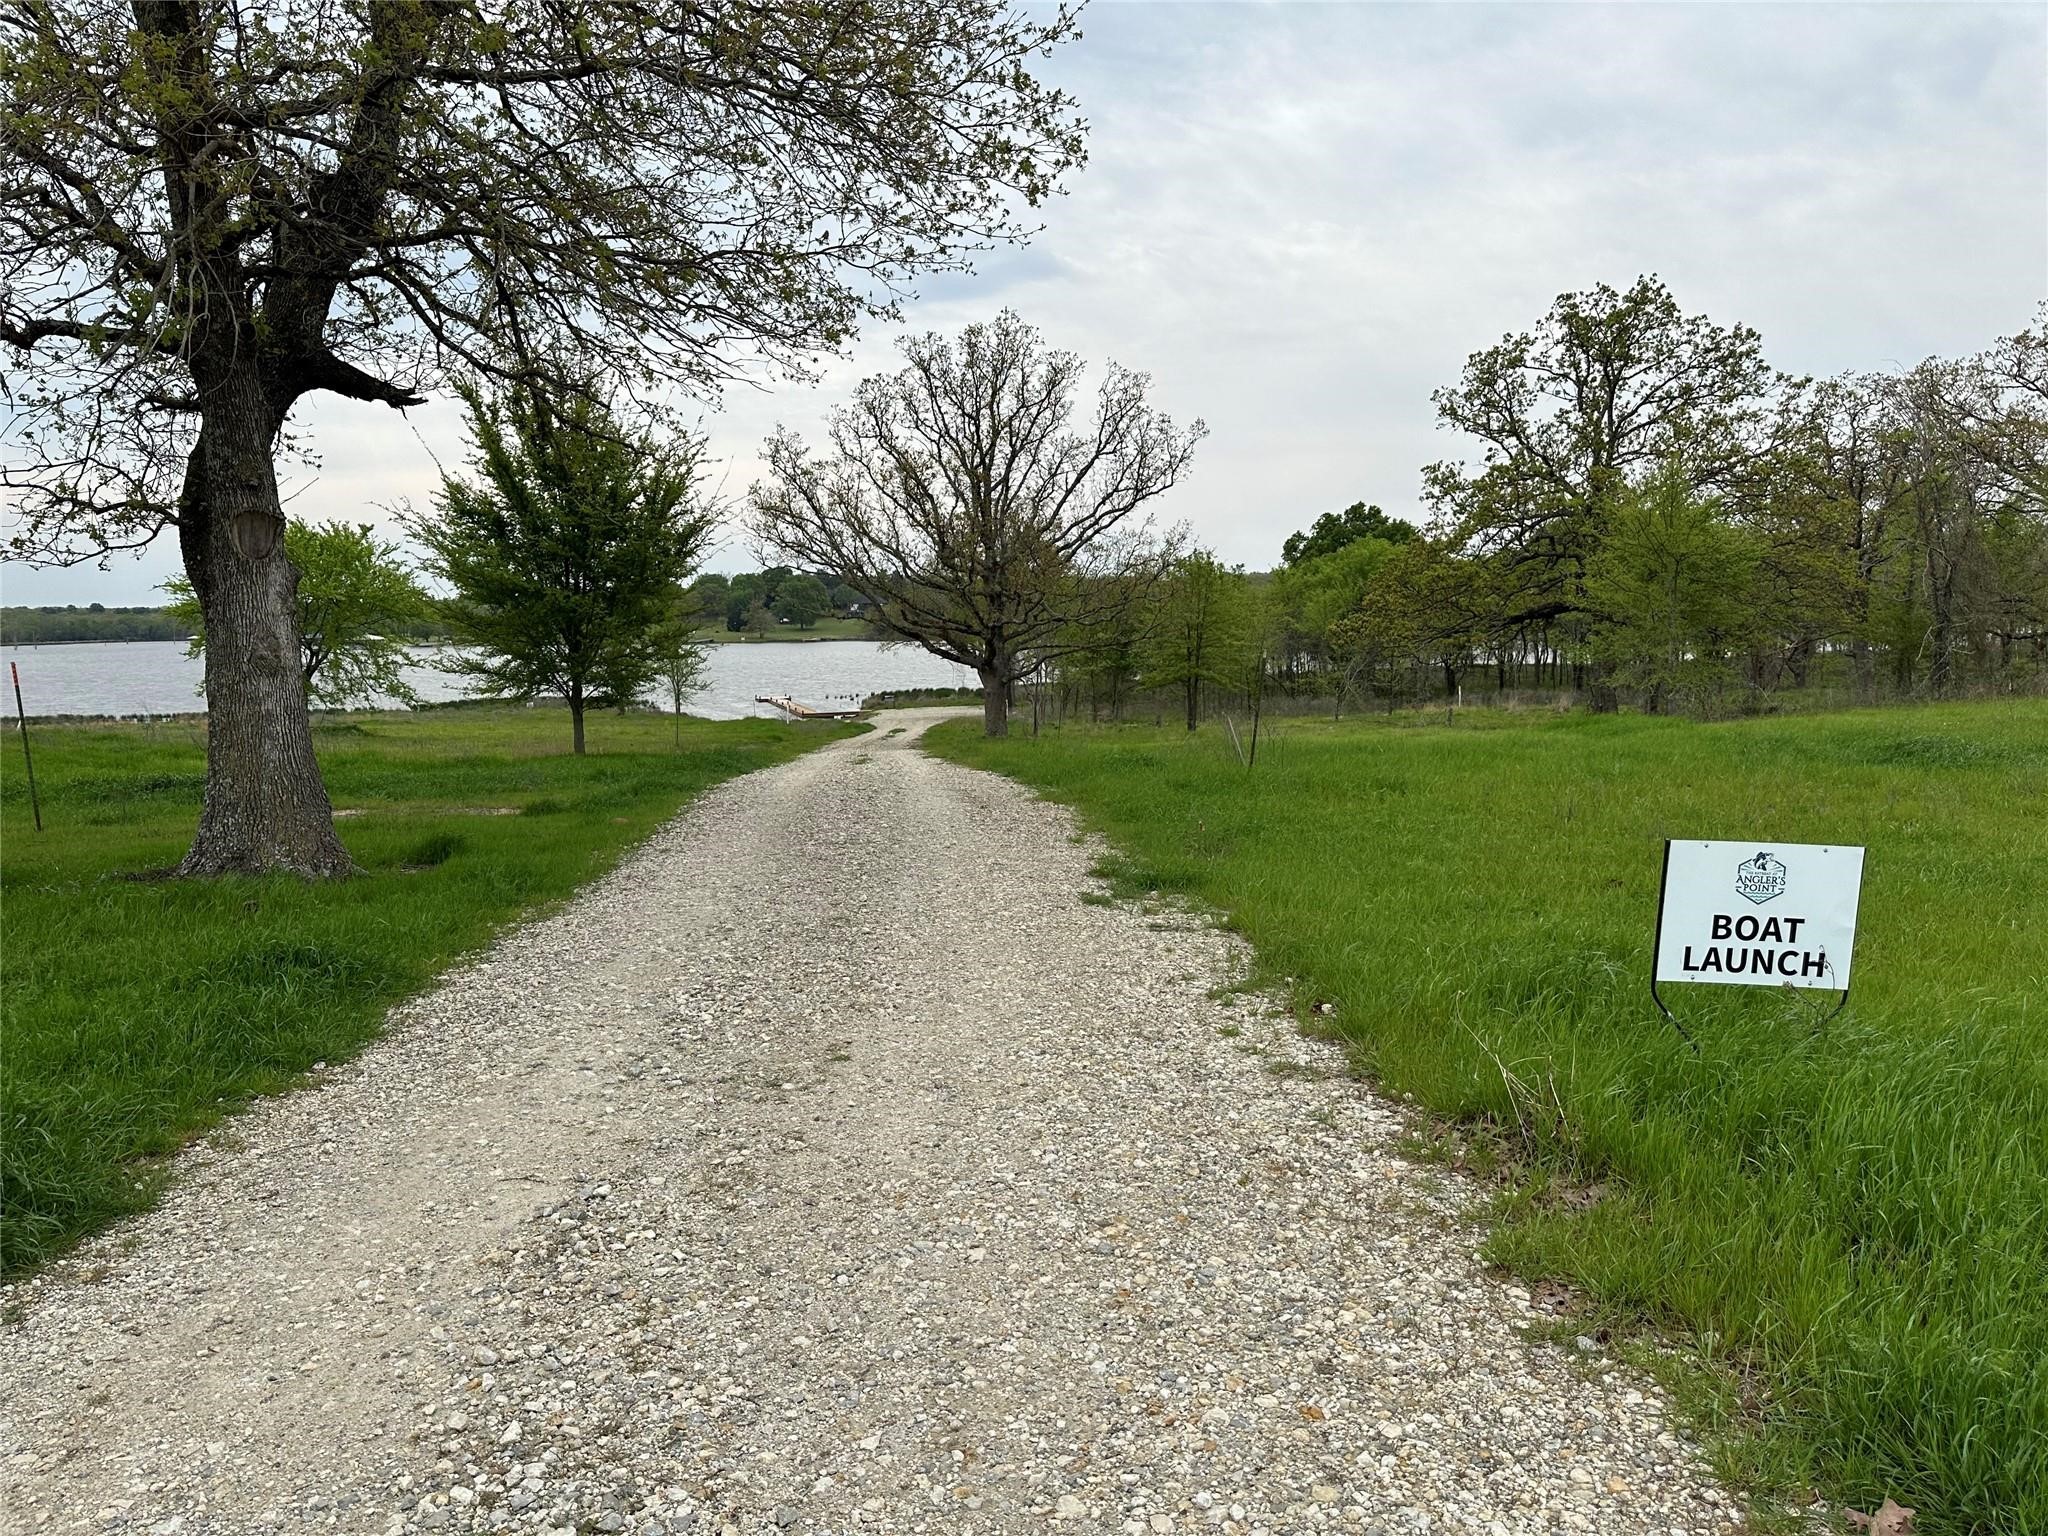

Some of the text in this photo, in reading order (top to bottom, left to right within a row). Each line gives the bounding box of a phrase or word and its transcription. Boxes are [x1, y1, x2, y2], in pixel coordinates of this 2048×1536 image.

[1736, 875, 1786, 886] ANGLER'S
[1743, 884, 1777, 892] POINT
[1711, 914, 1805, 943] BOAT
[1683, 946, 1826, 977] LAUNCH
